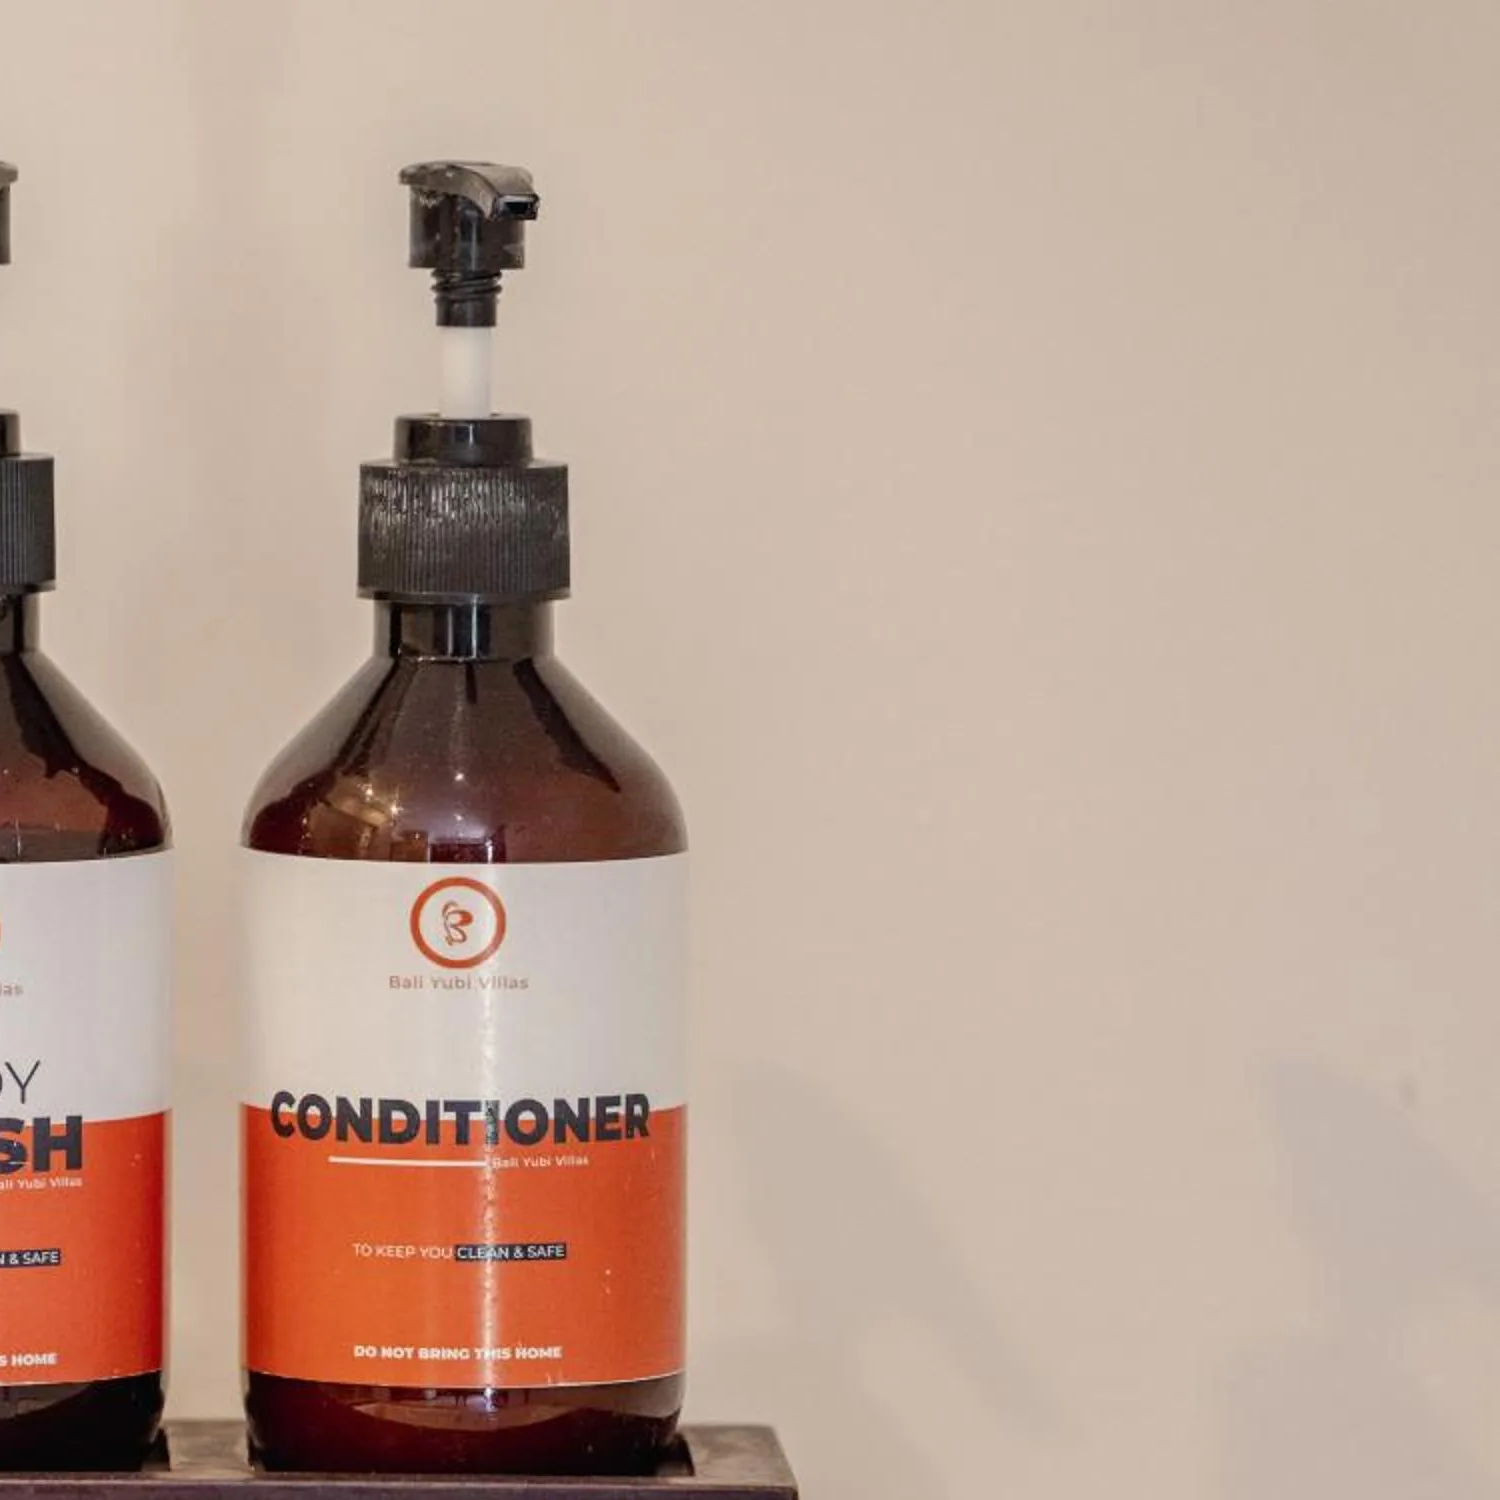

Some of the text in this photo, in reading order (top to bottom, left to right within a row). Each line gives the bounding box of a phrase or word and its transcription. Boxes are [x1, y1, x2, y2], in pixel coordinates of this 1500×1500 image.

[388, 975, 529, 990] Bali Yubi Villas
[271, 1090, 651, 1146] CONDITIONER
[492, 1155, 589, 1169] Bali Yubi Villas
[17, 1178, 46, 1190] Yubi
[50, 1176, 83, 1188] Villas
[8, 1252, 20, 1265] &
[23, 1251, 59, 1265] SAFE
[352, 1243, 564, 1259] TO KEEP YOU CLEAN & SAFE
[11, 1353, 57, 1365] HOME
[353, 1345, 563, 1360] DO NOT BRING THIS HOME
